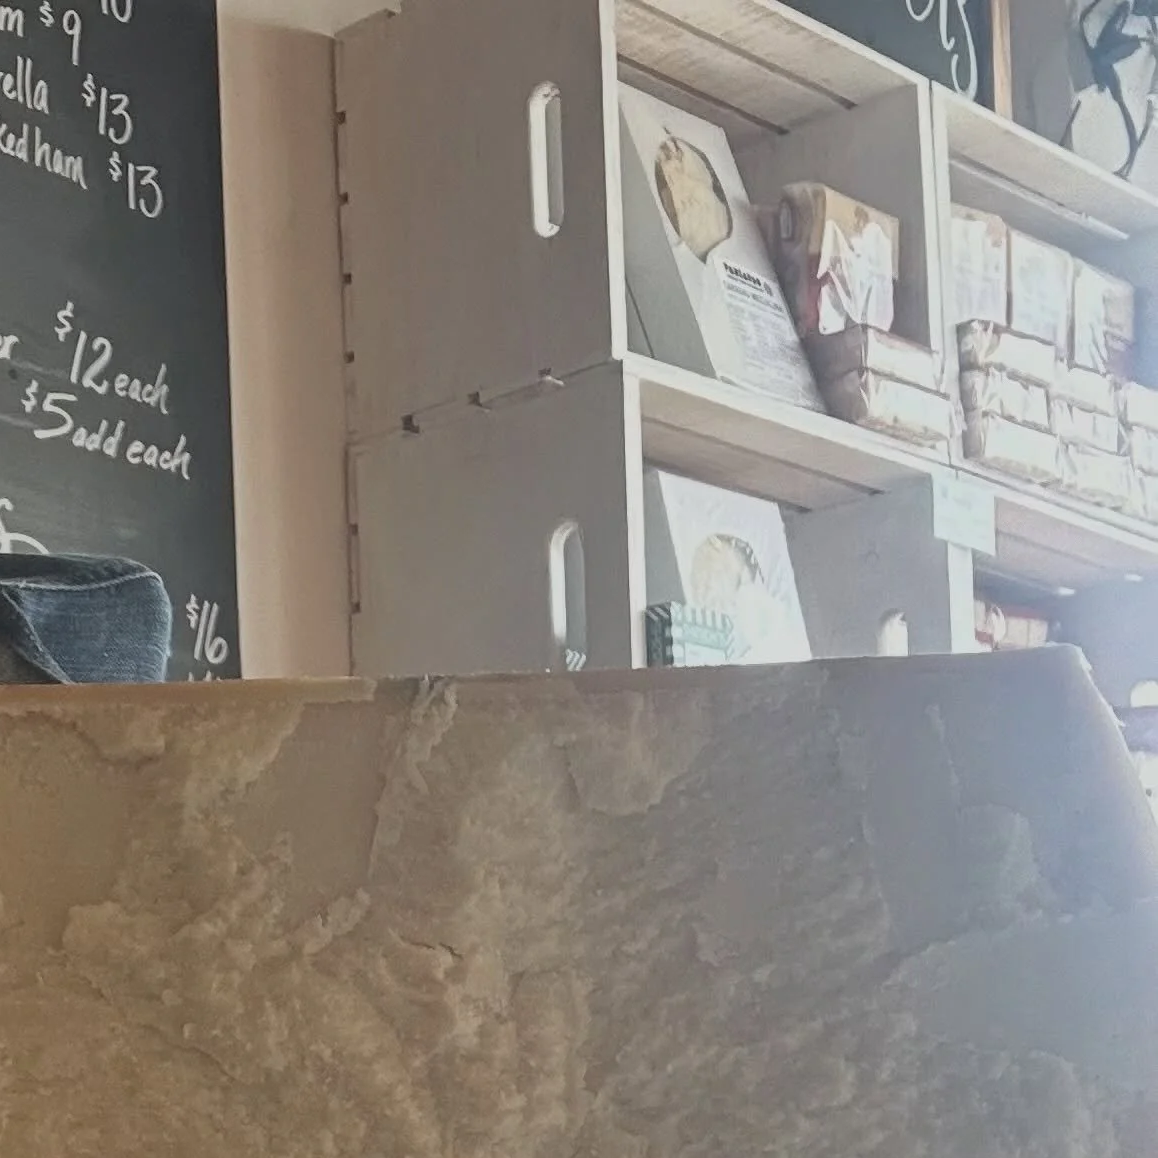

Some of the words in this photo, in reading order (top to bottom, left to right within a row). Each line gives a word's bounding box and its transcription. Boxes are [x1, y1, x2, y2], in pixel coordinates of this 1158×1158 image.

[81, 72, 134, 145] $13
[34, 121, 89, 190] ham
[108, 150, 165, 218] $13
[53, 300, 114, 396] $12
[113, 363, 173, 415] each
[20, 379, 79, 440] $5
[71, 419, 126, 459] add
[125, 433, 192, 482] each
